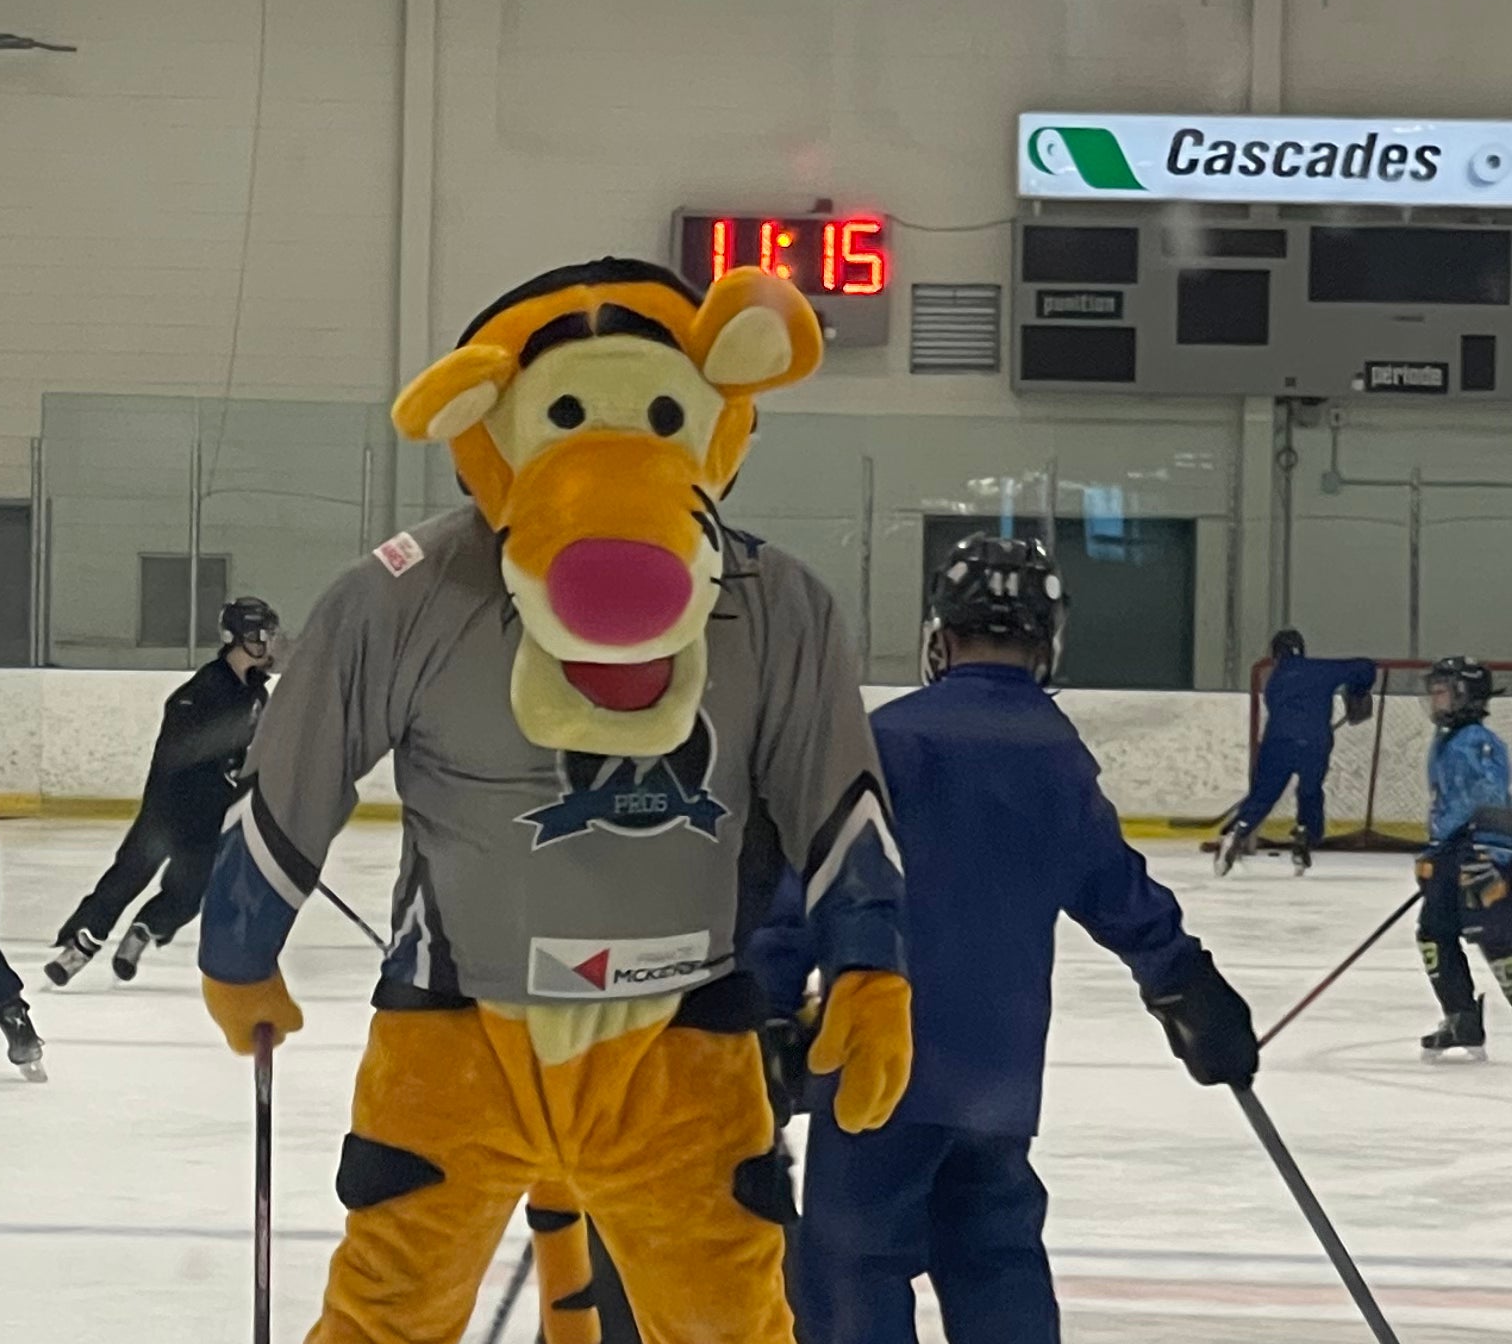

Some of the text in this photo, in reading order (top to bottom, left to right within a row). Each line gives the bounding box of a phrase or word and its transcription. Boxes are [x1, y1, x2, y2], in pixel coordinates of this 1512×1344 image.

[1166, 128, 1442, 182] Cascades
[712, 220, 885, 294] 11:15
[613, 792, 668, 815] PROS
